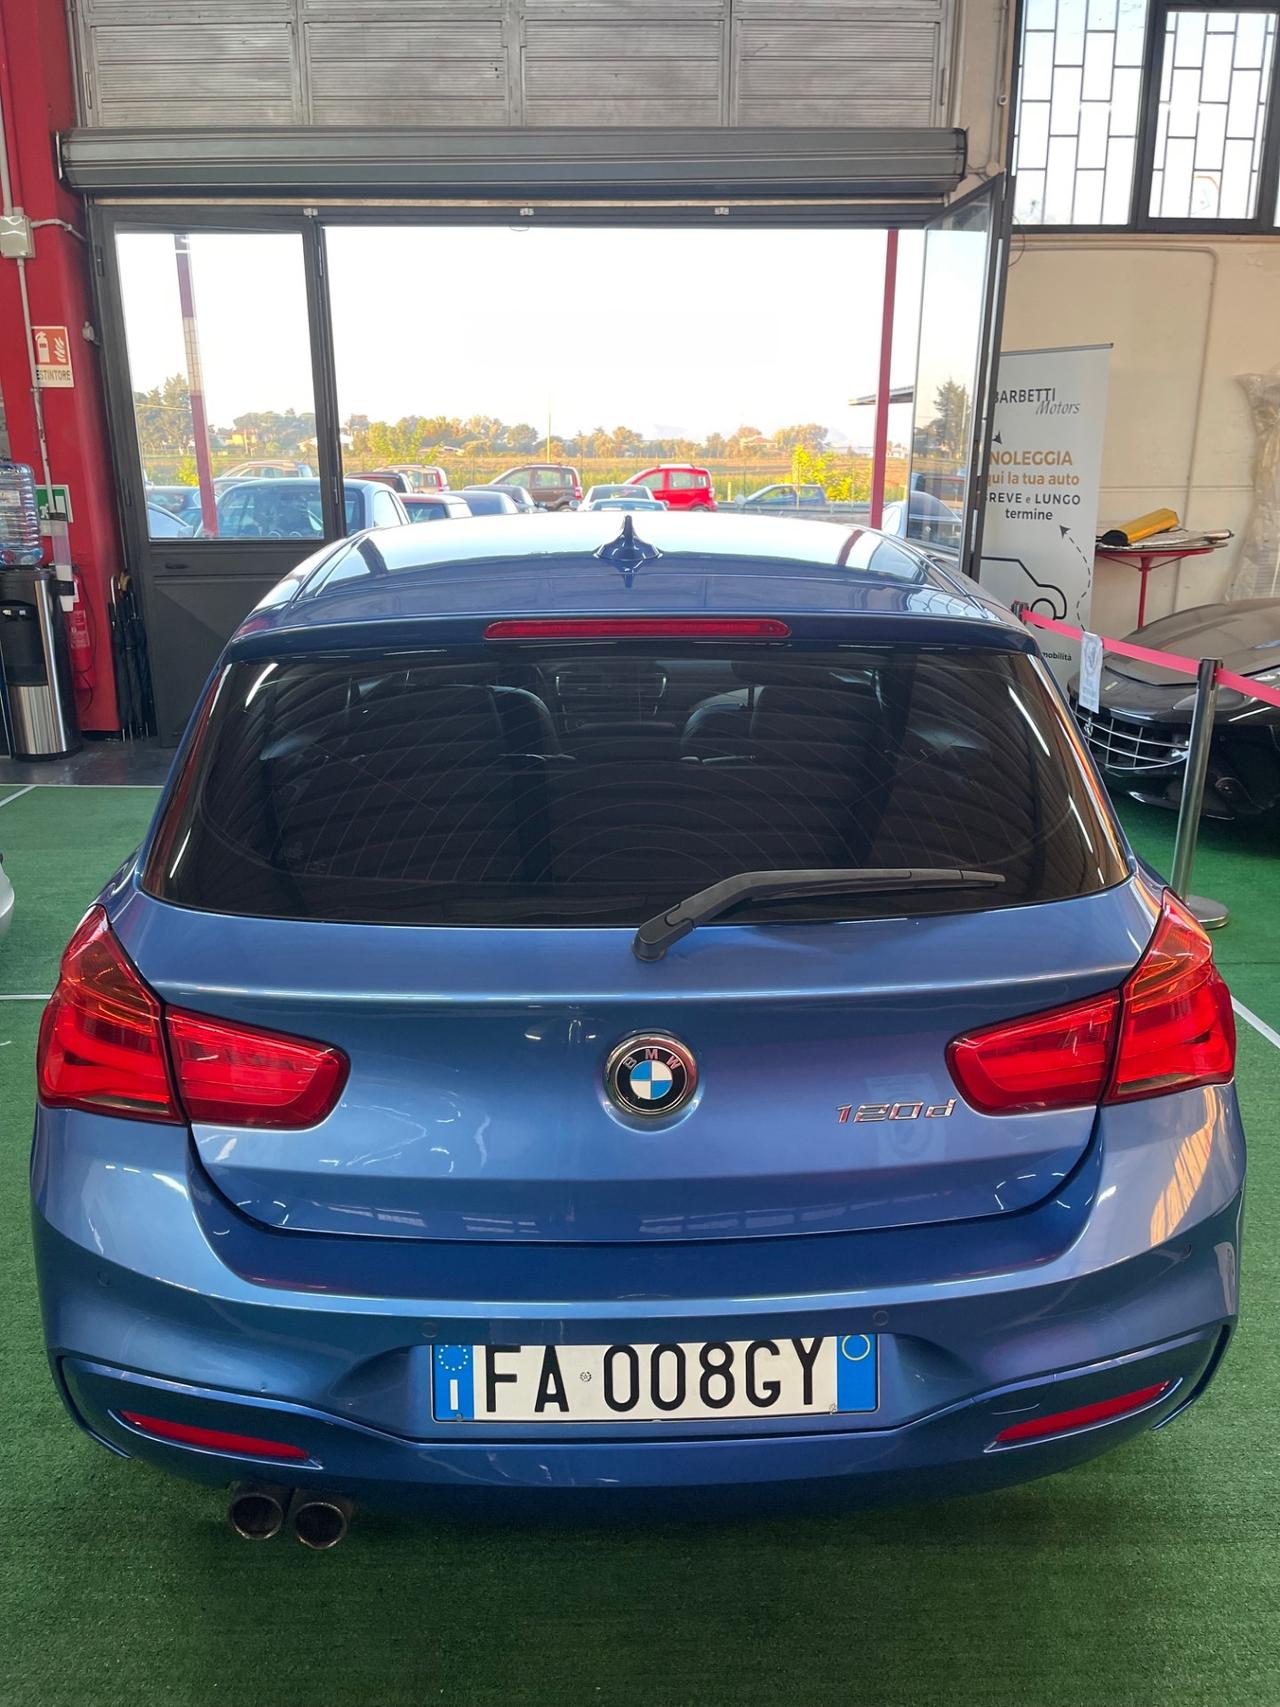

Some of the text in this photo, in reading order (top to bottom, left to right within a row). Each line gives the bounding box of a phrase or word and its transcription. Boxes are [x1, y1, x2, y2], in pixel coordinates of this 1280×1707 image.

[1035, 400, 1081, 415] Motors
[989, 450, 1073, 466] NOLEGGIA
[1007, 472, 1019, 485] la
[1022, 473, 1045, 485] tua
[1048, 473, 1080, 486] auto
[1025, 496, 1031, 504] e
[1035, 493, 1081, 505] LUNGO
[1005, 508, 1053, 520] termine
[622, 1048, 682, 1071] BMW
[835, 1098, 957, 1125] 120d
[485, 1336, 825, 1413] FA 008GY
